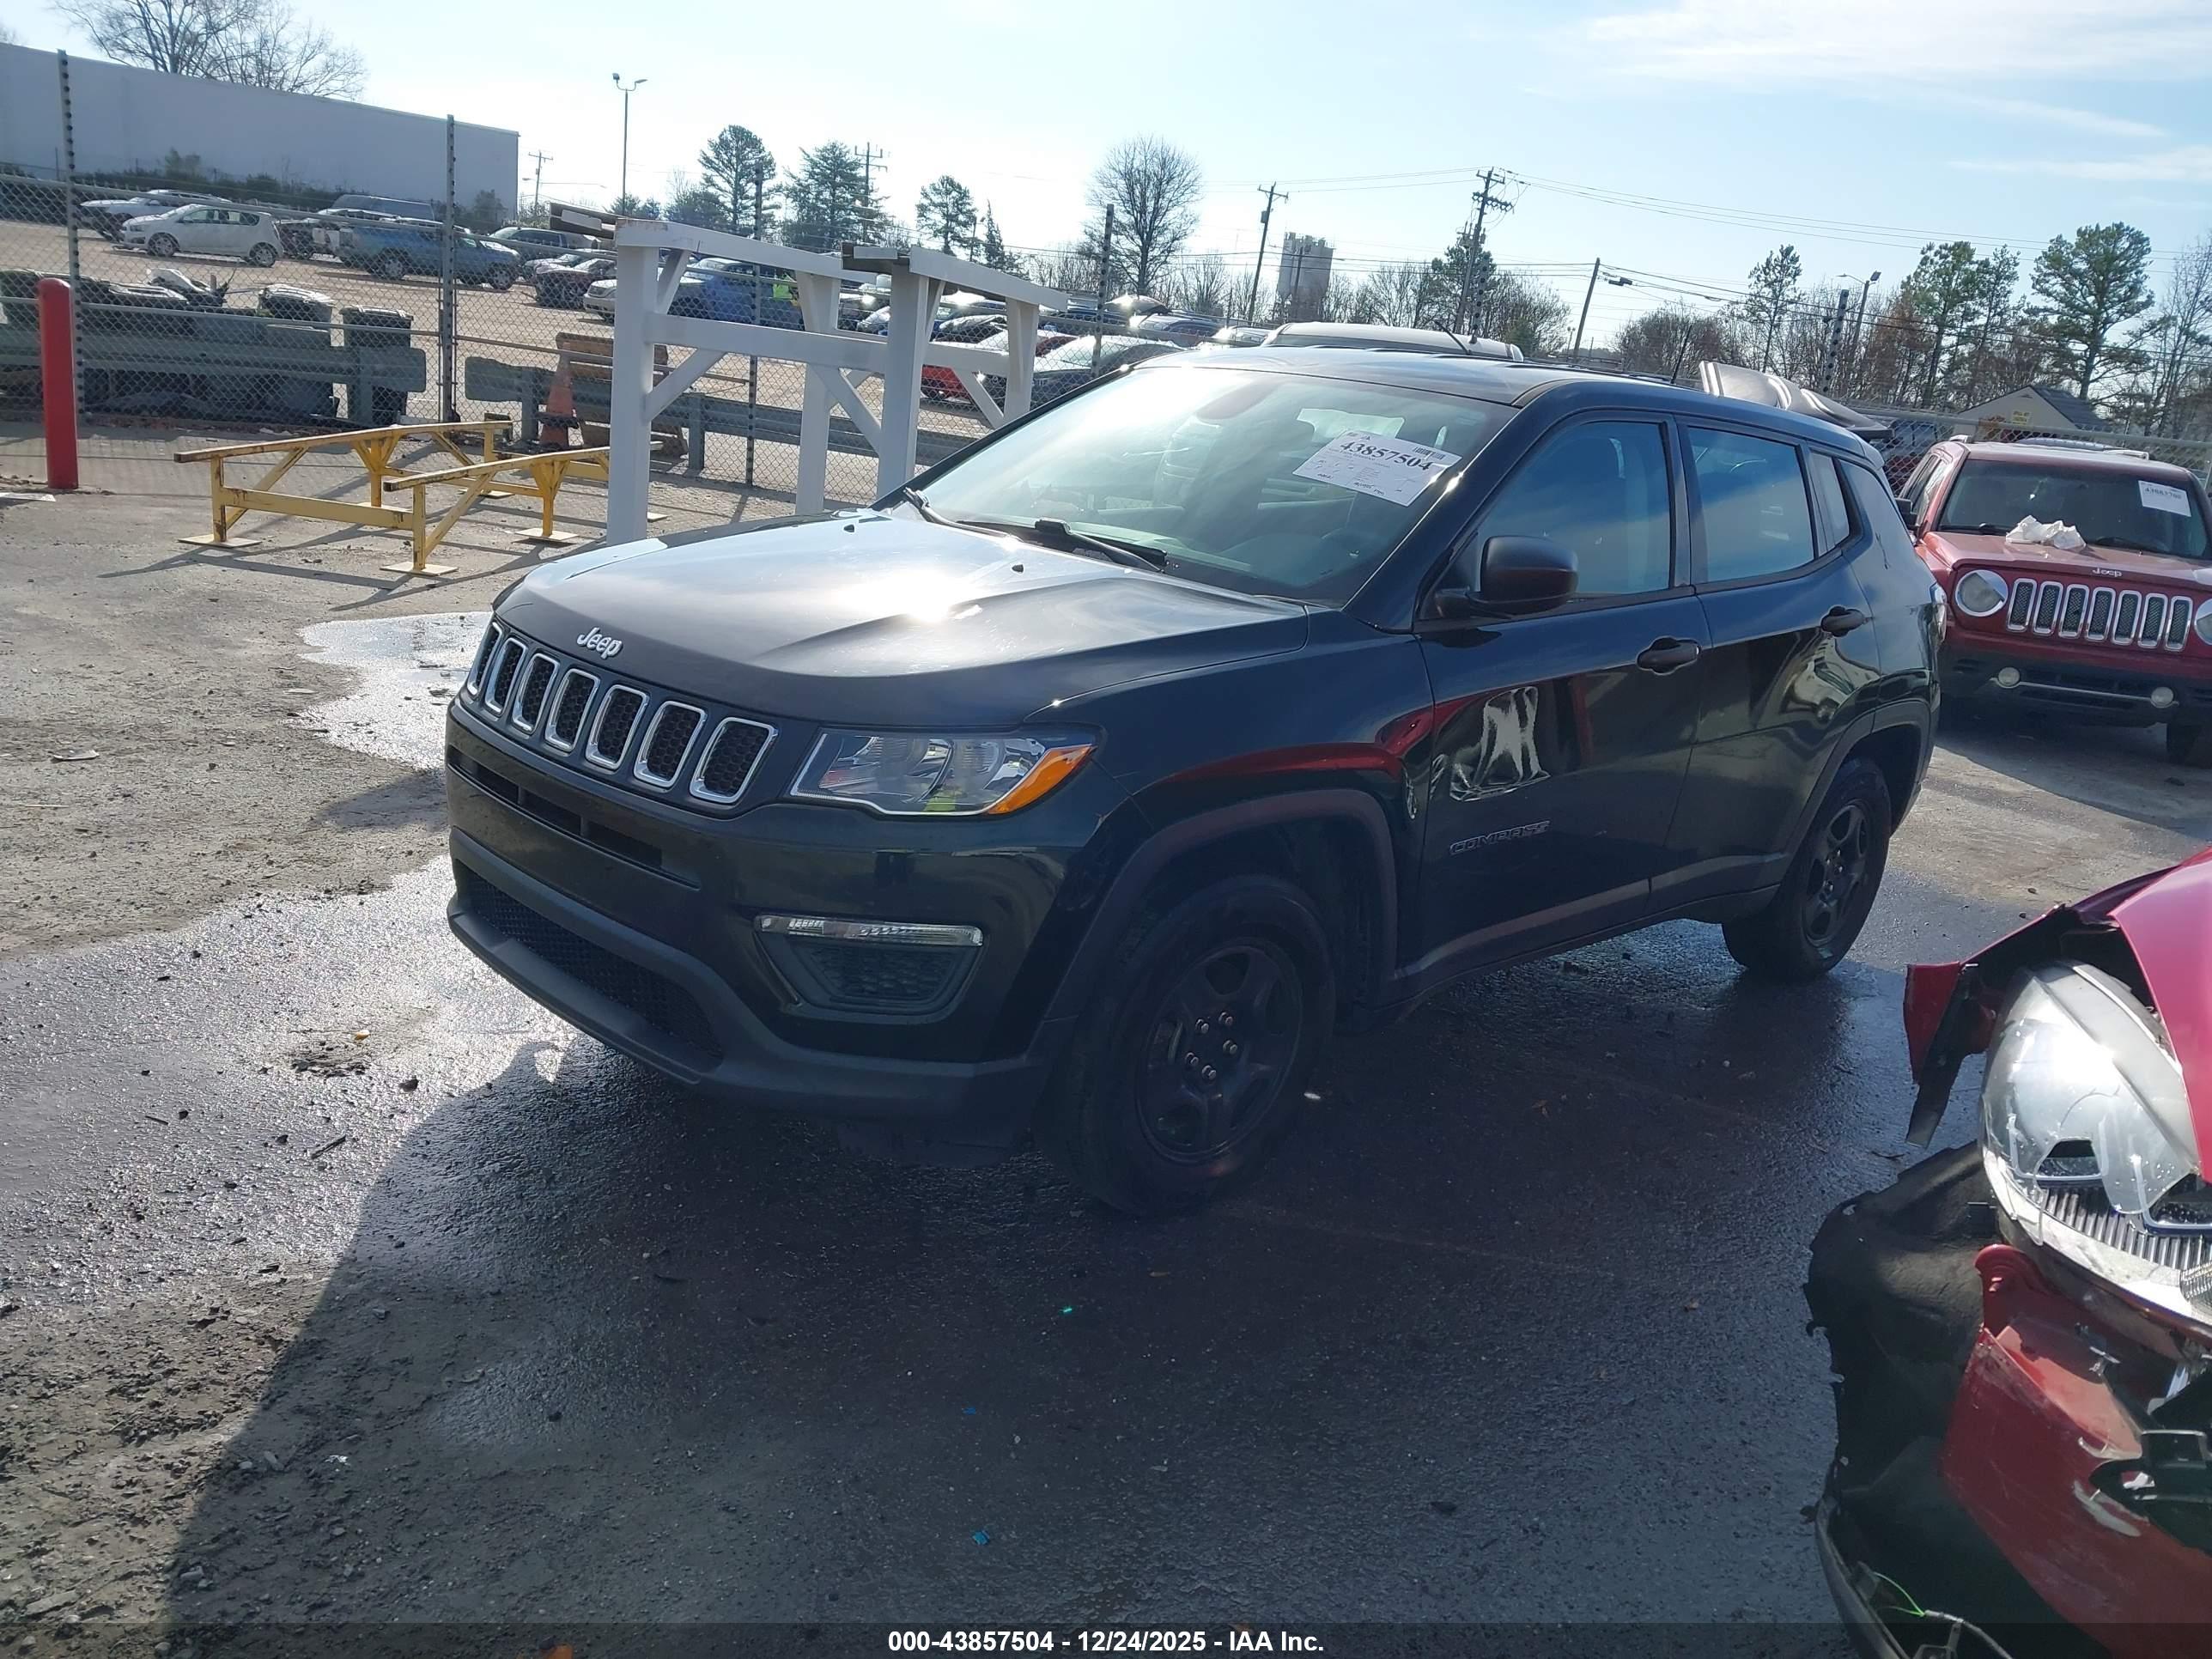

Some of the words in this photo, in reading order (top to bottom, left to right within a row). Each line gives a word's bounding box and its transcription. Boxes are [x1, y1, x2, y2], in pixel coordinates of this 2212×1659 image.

[1340, 441, 1433, 471] 43857504
[2093, 568, 2122, 577] Jeep
[576, 627, 622, 659] Jeep
[1449, 820, 1551, 855] COMPASS
